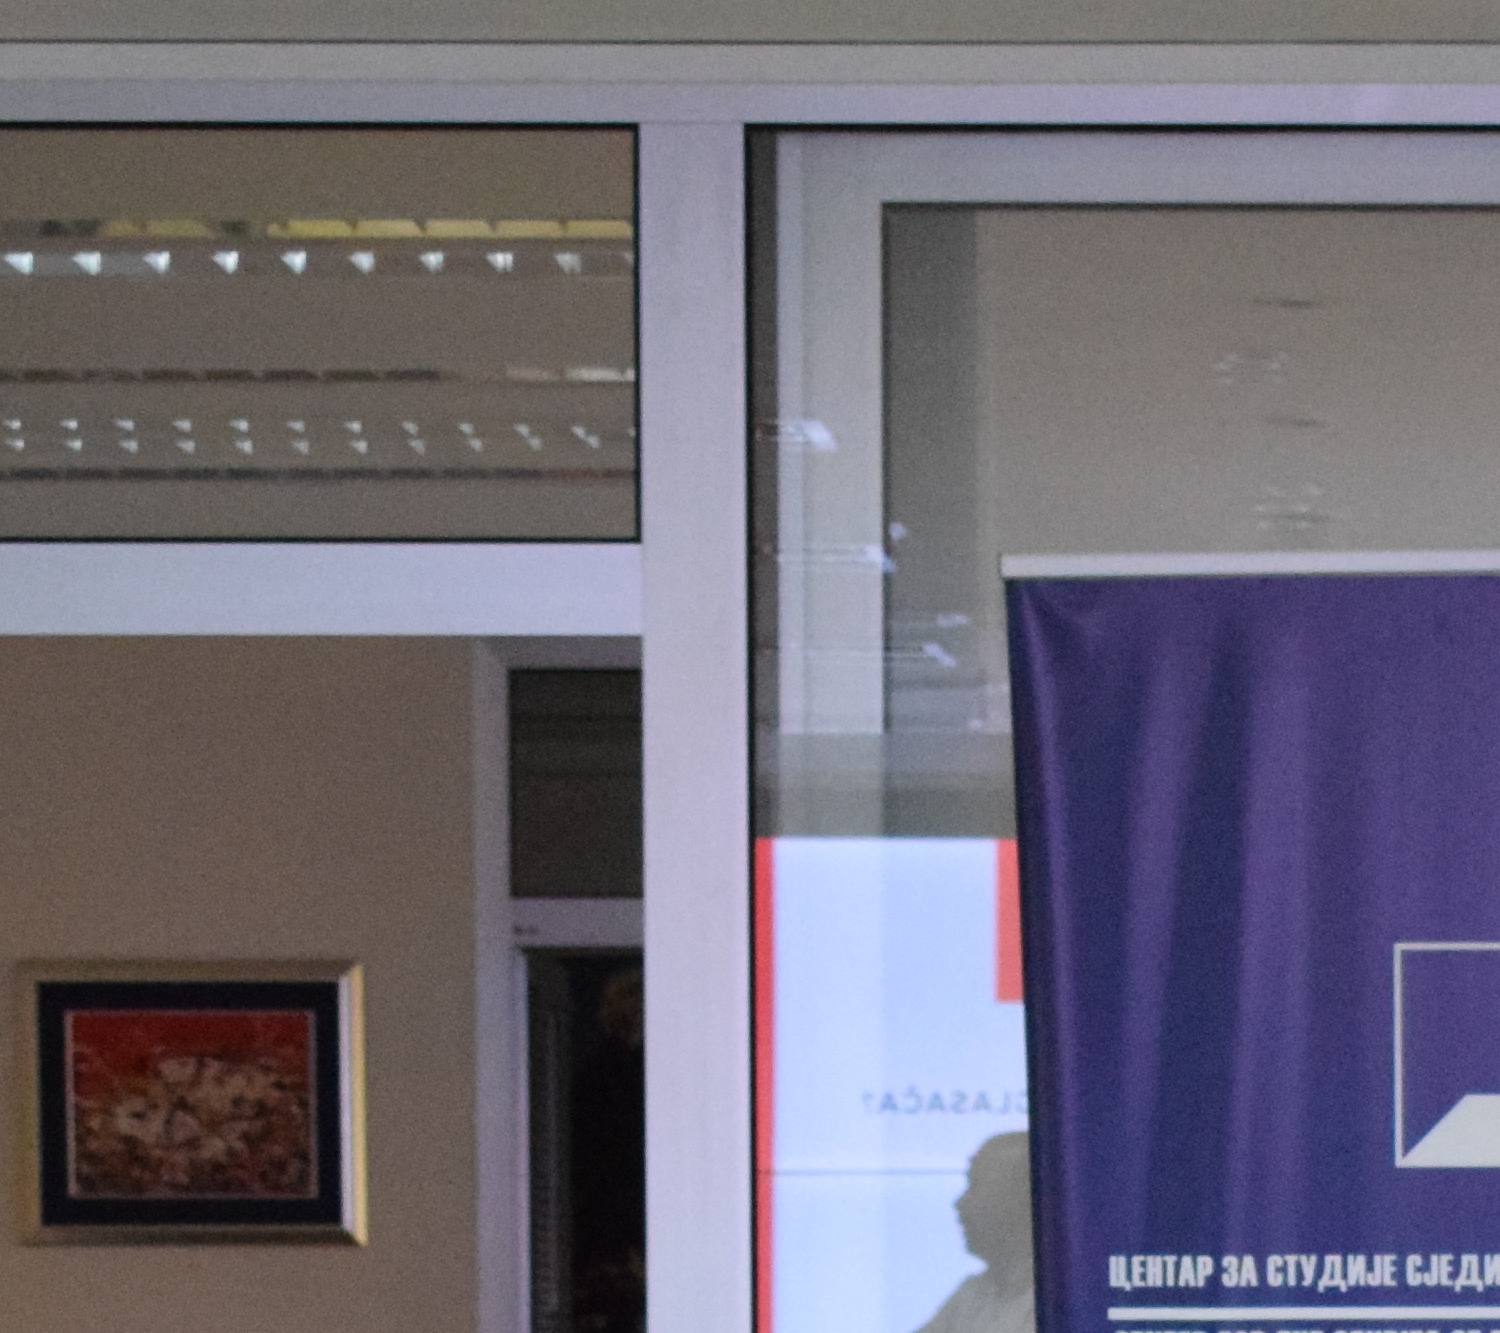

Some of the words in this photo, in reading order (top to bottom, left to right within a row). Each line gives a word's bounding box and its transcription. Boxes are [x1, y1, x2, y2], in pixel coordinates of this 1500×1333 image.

[1108, 1254, 1214, 1291] ЦЕНТАР
[1220, 1254, 1259, 1288] ЗА
[1266, 1254, 1398, 1293] СТУДИЈЕ
